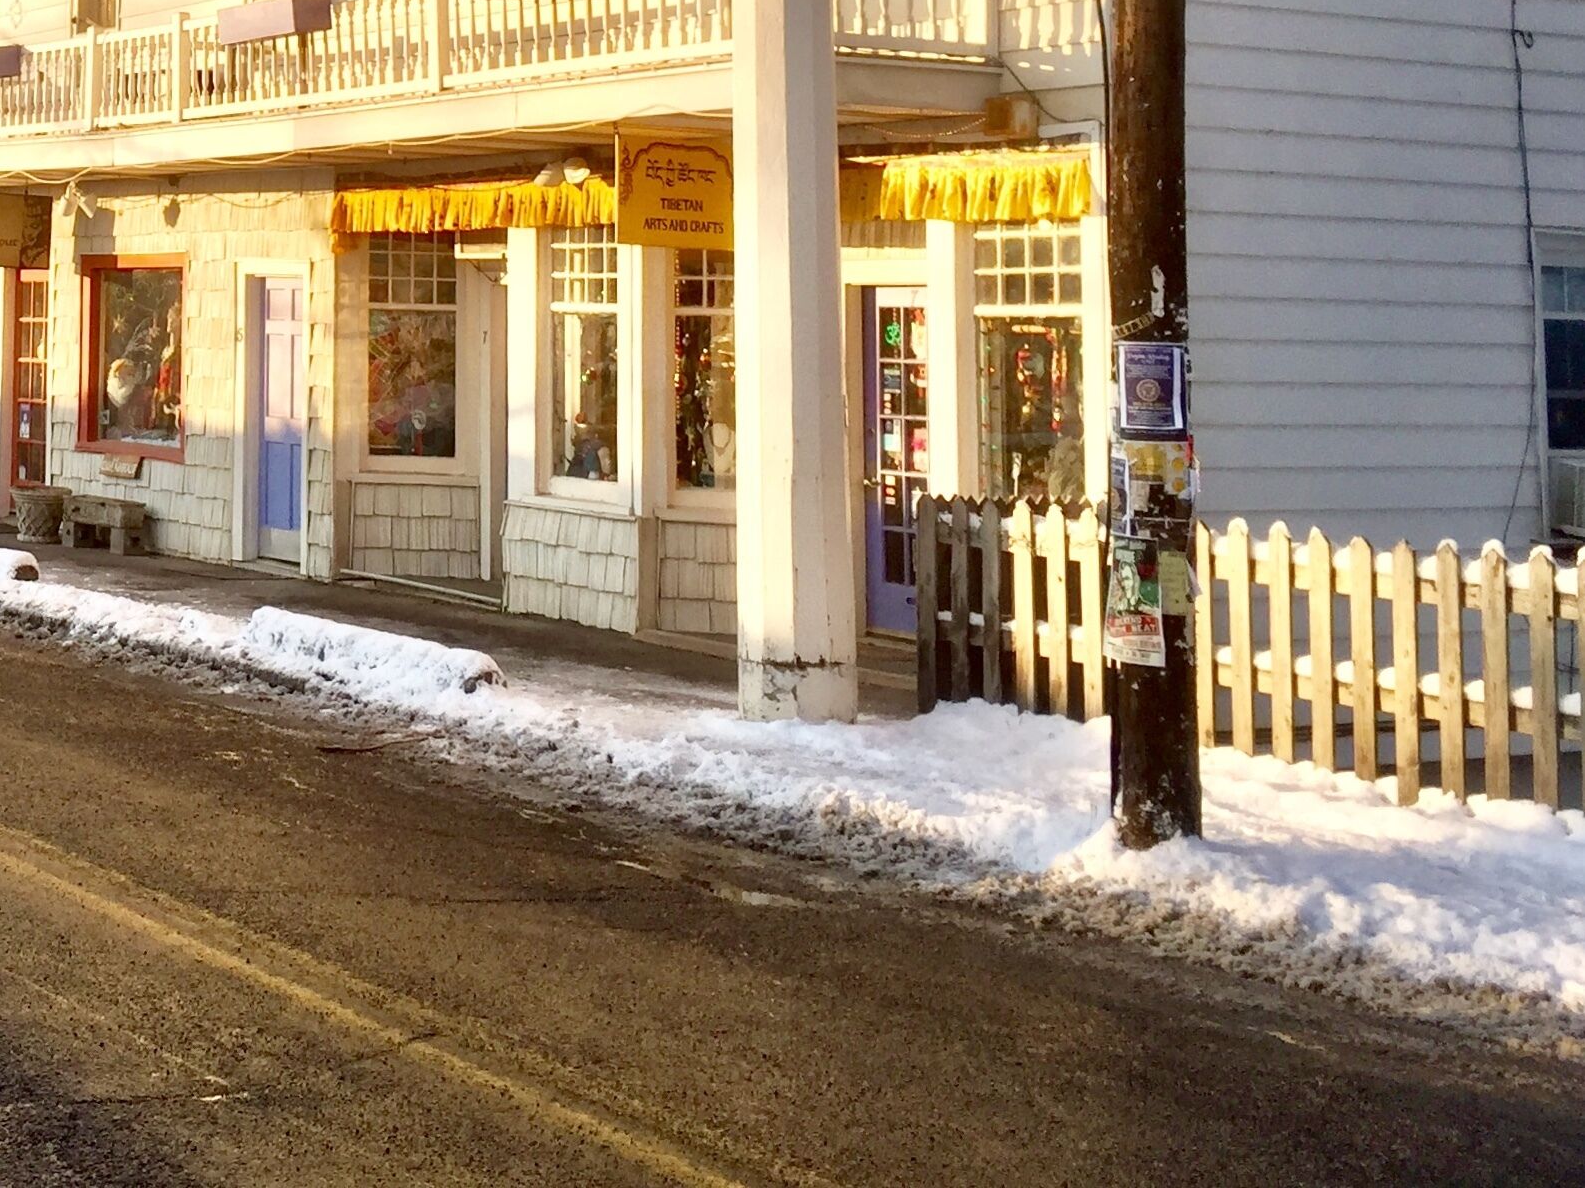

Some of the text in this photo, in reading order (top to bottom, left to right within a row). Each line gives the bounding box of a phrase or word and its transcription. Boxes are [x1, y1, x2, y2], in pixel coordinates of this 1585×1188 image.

[660, 197, 703, 212] TIBETAN
[643, 217, 724, 234] ARTS AND CRAFTS
